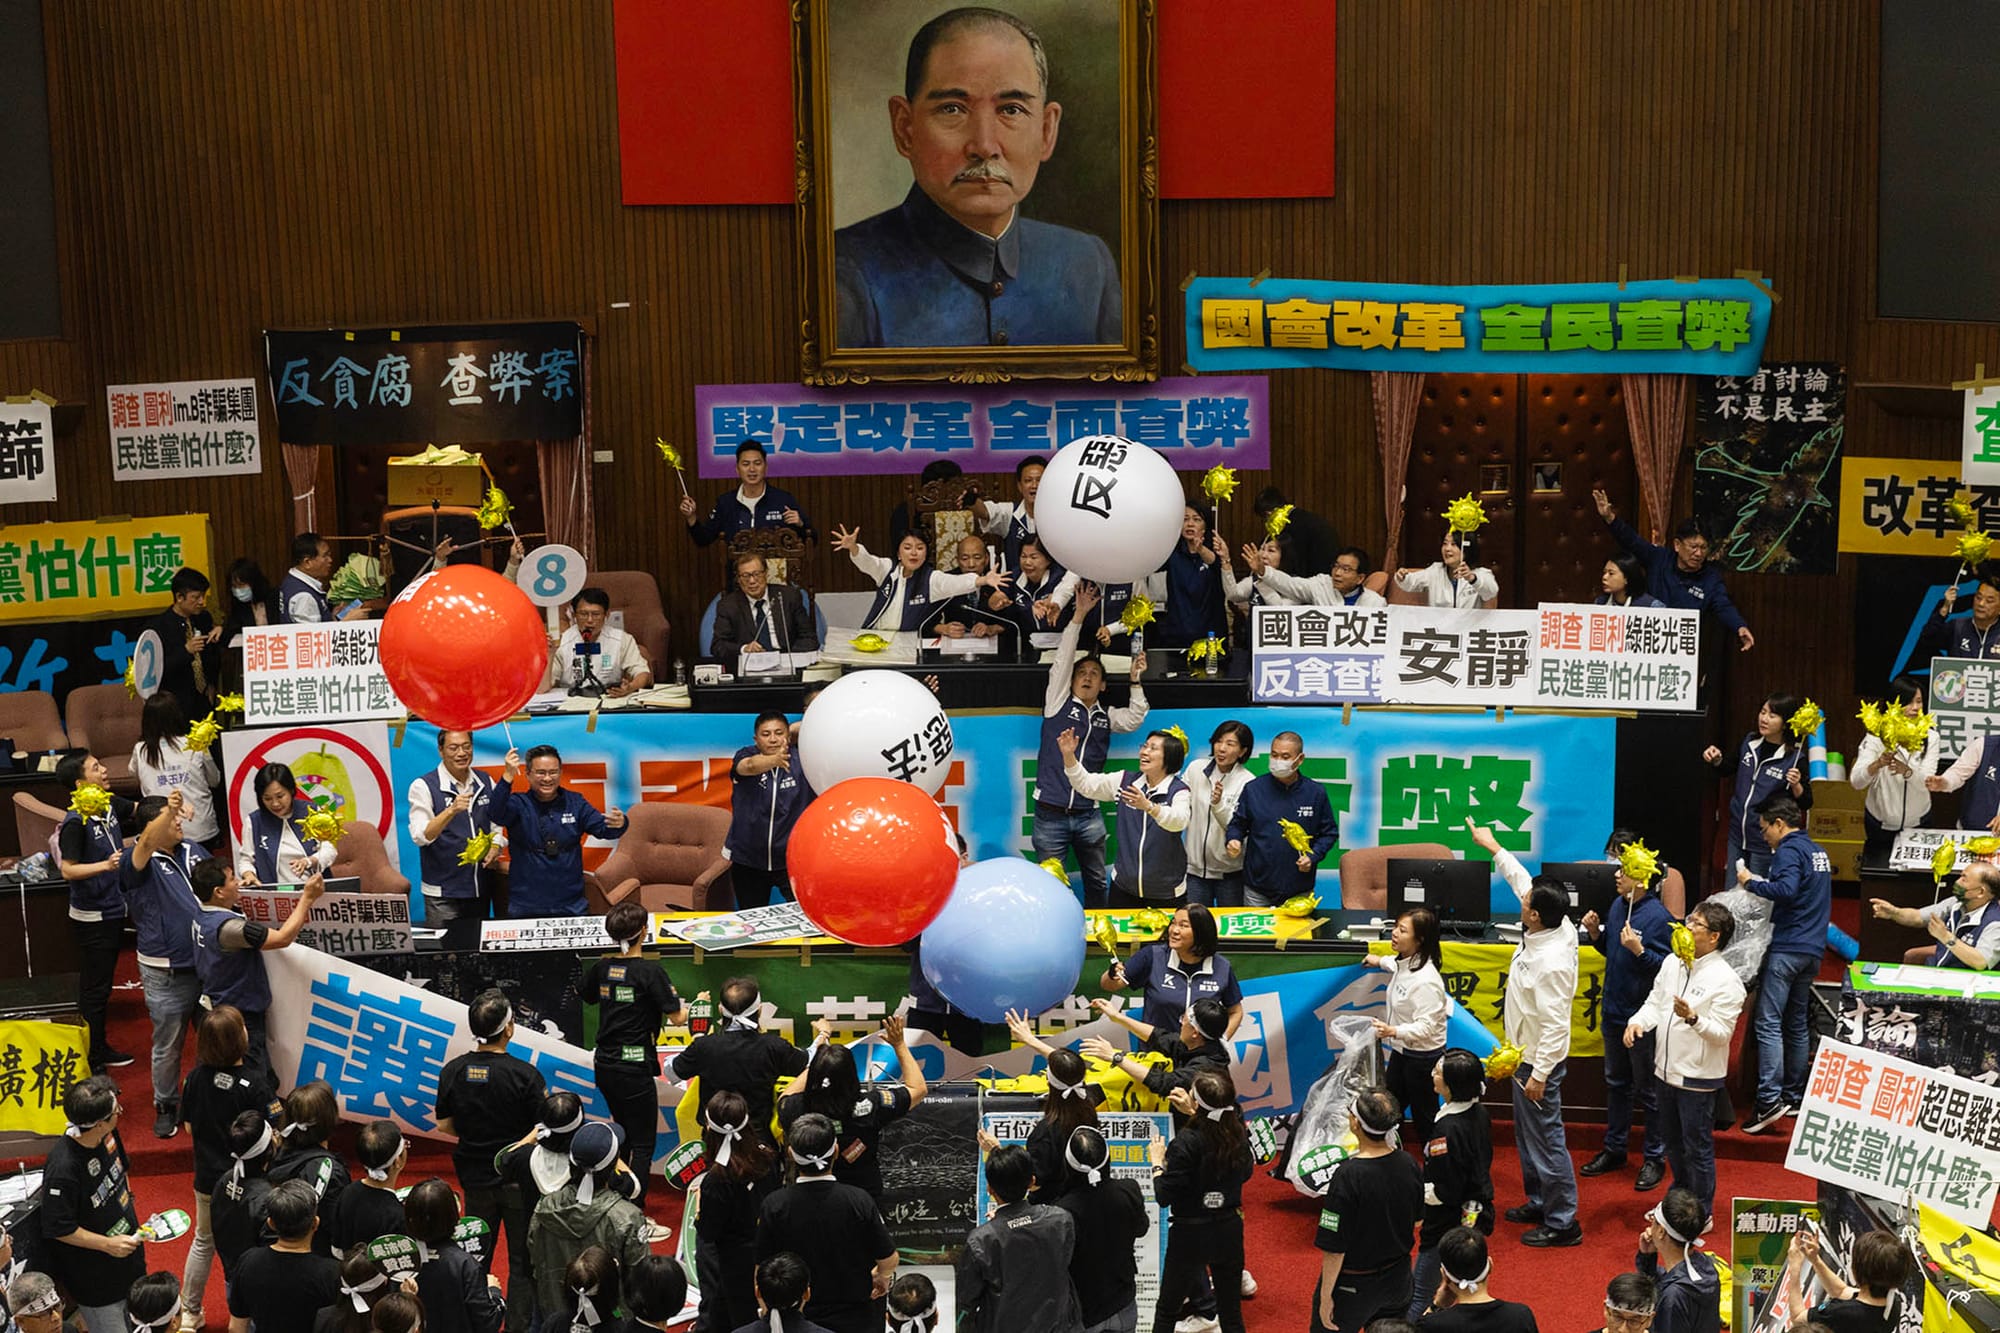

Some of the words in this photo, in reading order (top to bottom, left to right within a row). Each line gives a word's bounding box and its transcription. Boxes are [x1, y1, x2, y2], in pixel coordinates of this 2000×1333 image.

[1203, 298, 1465, 351] 國會改革
[1480, 298, 1751, 352] 全民查弊
[278, 353, 412, 409] 反貪腐
[440, 348, 577, 406] 查弊案
[111, 391, 141, 429] 調查
[713, 402, 973, 456] 堅定改革
[988, 396, 1251, 452] 全面查弊
[1714, 396, 1829, 422] 不是民主
[116, 430, 256, 471] 民進黨怕什麼?
[533, 553, 567, 597] 8
[246, 633, 289, 672] 調查
[1400, 626, 1529, 688] 安靜
[1541, 610, 1583, 650] 調查
[1588, 611, 1697, 657] 圖利綠能光電
[141, 639, 156, 690] 2
[1537, 657, 1692, 703] 民進黨怕什麼?
[1811, 1048, 1872, 1111] 調查
[1793, 1109, 1993, 1211] 民進黨怕什麼?
